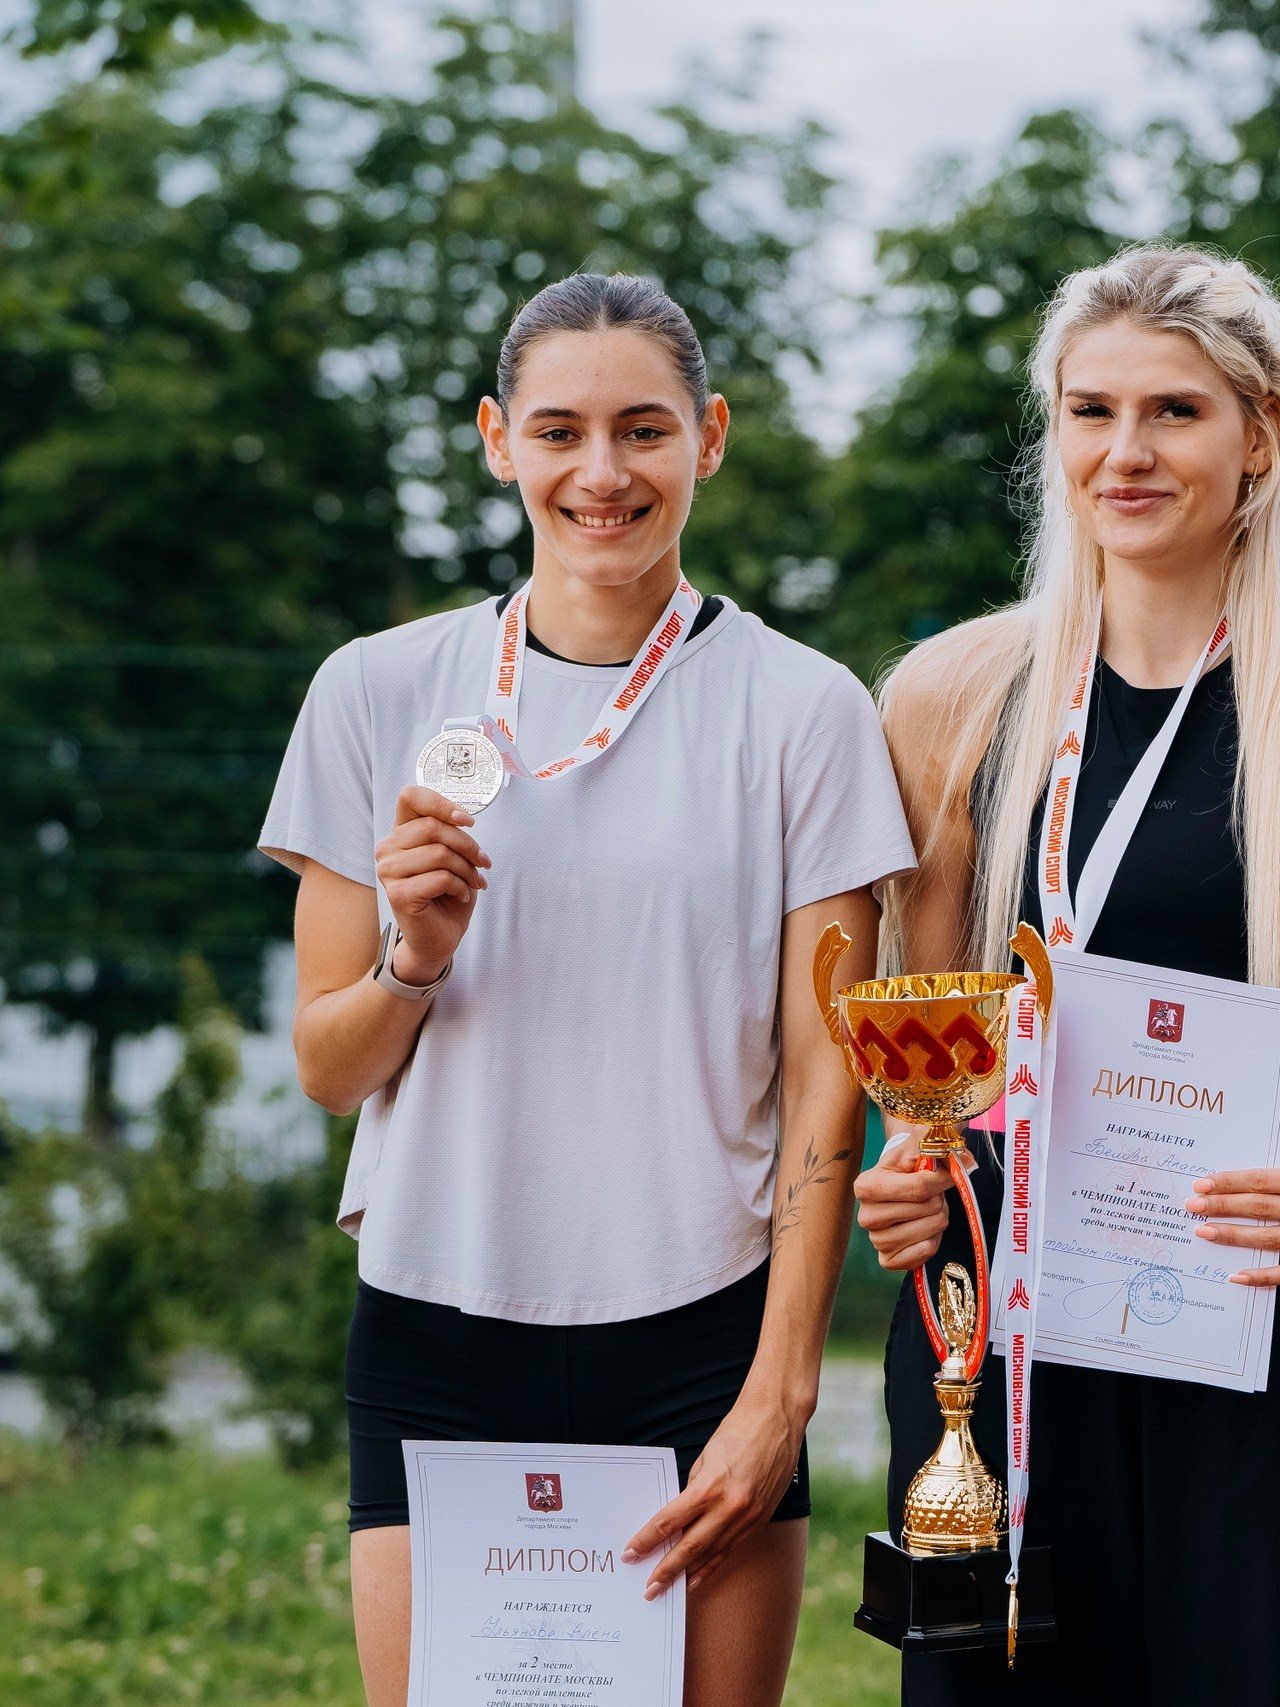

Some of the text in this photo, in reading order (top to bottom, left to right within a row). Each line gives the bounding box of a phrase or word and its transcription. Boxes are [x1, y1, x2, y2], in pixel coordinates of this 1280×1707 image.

[612, 610, 685, 712] МОСКОВСКИЙ СПОРТ
[496, 665, 515, 697] СПОРТ
[1046, 776, 1071, 894] МОСКОВСКИЙ СПОРТ
[1017, 998, 1036, 1040] СПОРТ
[1092, 1068, 1224, 1115] ДИПЛОМ
[1105, 1123, 1196, 1148] НАГРАЖДАЕТСЯ
[1013, 1119, 1032, 1255] МОСКОВСКИЙ СПОРТ
[1114, 1181, 1170, 1201] за 1 место
[1080, 1189, 1158, 1213] ЧЕМПИОНАТЕ
[1080, 1217, 1105, 1228] среди
[1106, 1222, 1144, 1236] мужчин
[1153, 1231, 1192, 1245] женщин
[1090, 1206, 1187, 1232] по легкой атлетике
[1012, 1334, 1024, 1469] МОСКОВСКИЙ СПОРТ
[516, 1515, 578, 1525] Департамент спорта
[484, 1547, 615, 1576] ДИПЛОМ
[504, 1601, 592, 1613] НАГРАЖДАЕТСЯ
[518, 1656, 573, 1670] за 2 место
[484, 1672, 562, 1685] ЧЕМПИОНАТЕ
[563, 1675, 614, 1687] МОСКВЫ
[495, 1687, 592, 1699] по легкой атлетике
